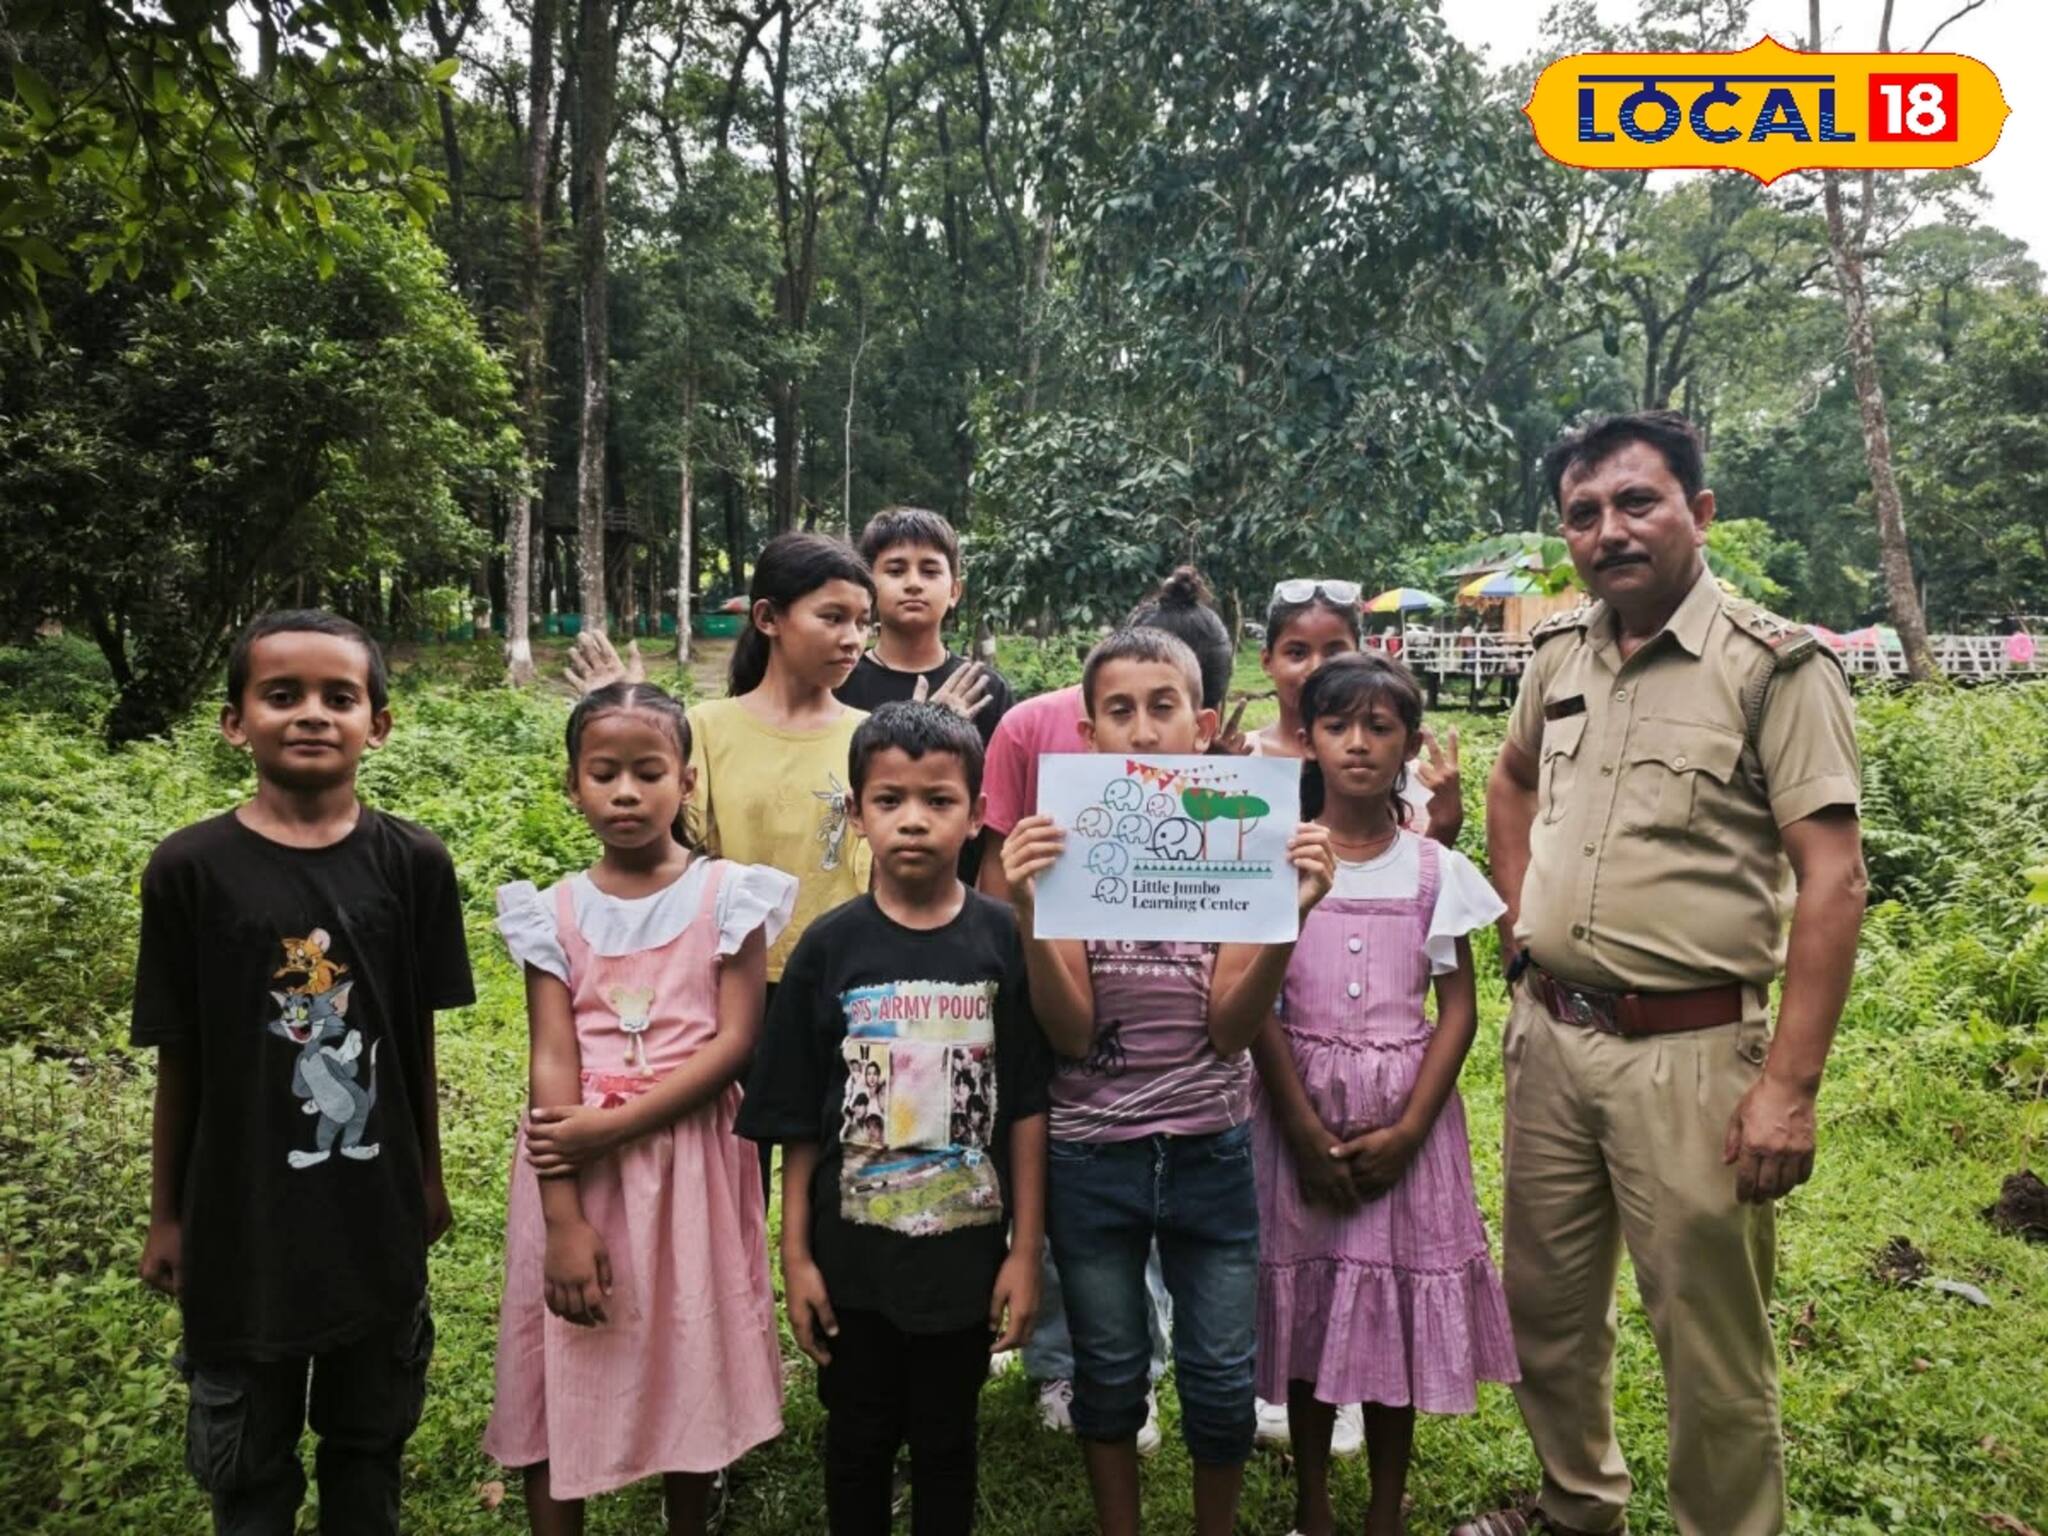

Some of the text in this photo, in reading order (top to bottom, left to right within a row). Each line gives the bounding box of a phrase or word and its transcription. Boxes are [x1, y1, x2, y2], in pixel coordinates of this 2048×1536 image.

[1132, 879, 1220, 896] Little Jumbo
[1132, 896, 1249, 912] Learning Center
[879, 995, 932, 1020] ARMY
